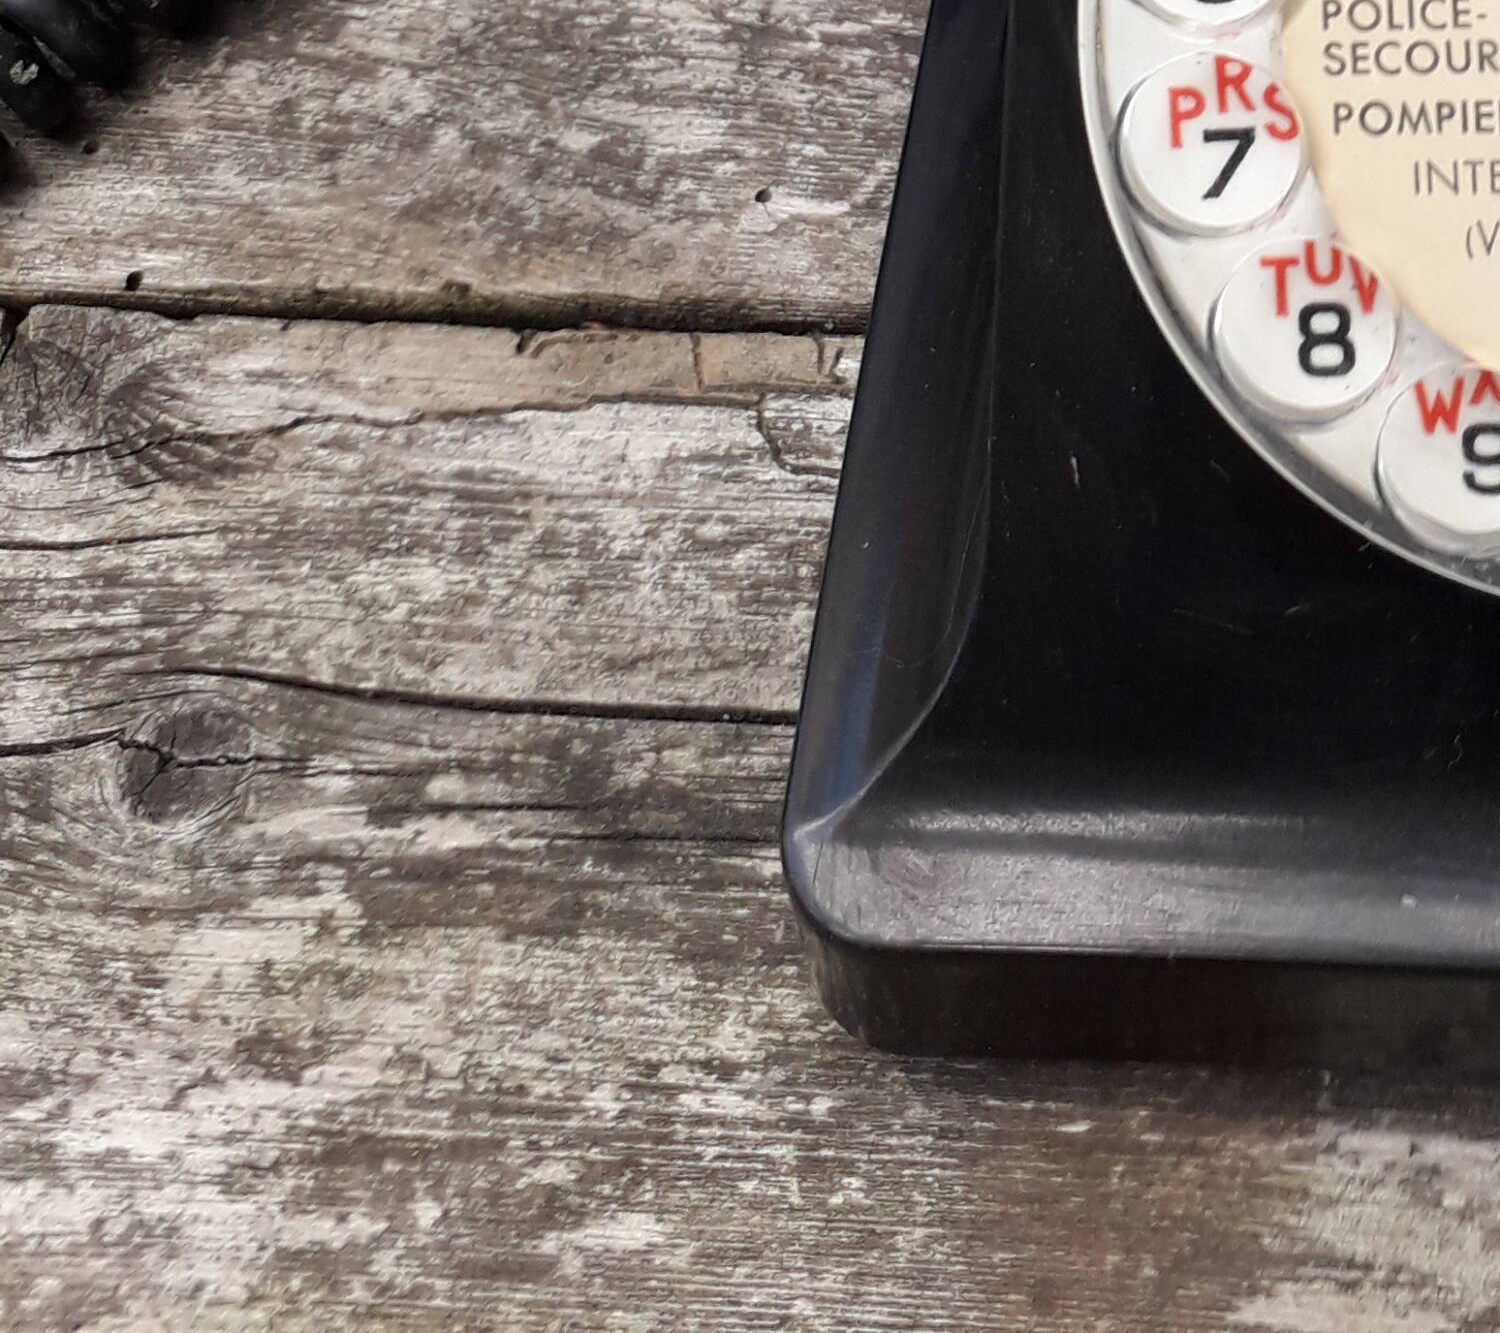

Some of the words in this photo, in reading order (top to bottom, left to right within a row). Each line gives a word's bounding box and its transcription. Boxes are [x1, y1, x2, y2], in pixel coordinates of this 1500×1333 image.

[1168, 56, 1300, 150] PRS
[1203, 128, 1255, 199] 7
[1259, 241, 1378, 318] TUV
[1298, 303, 1356, 377] 8
